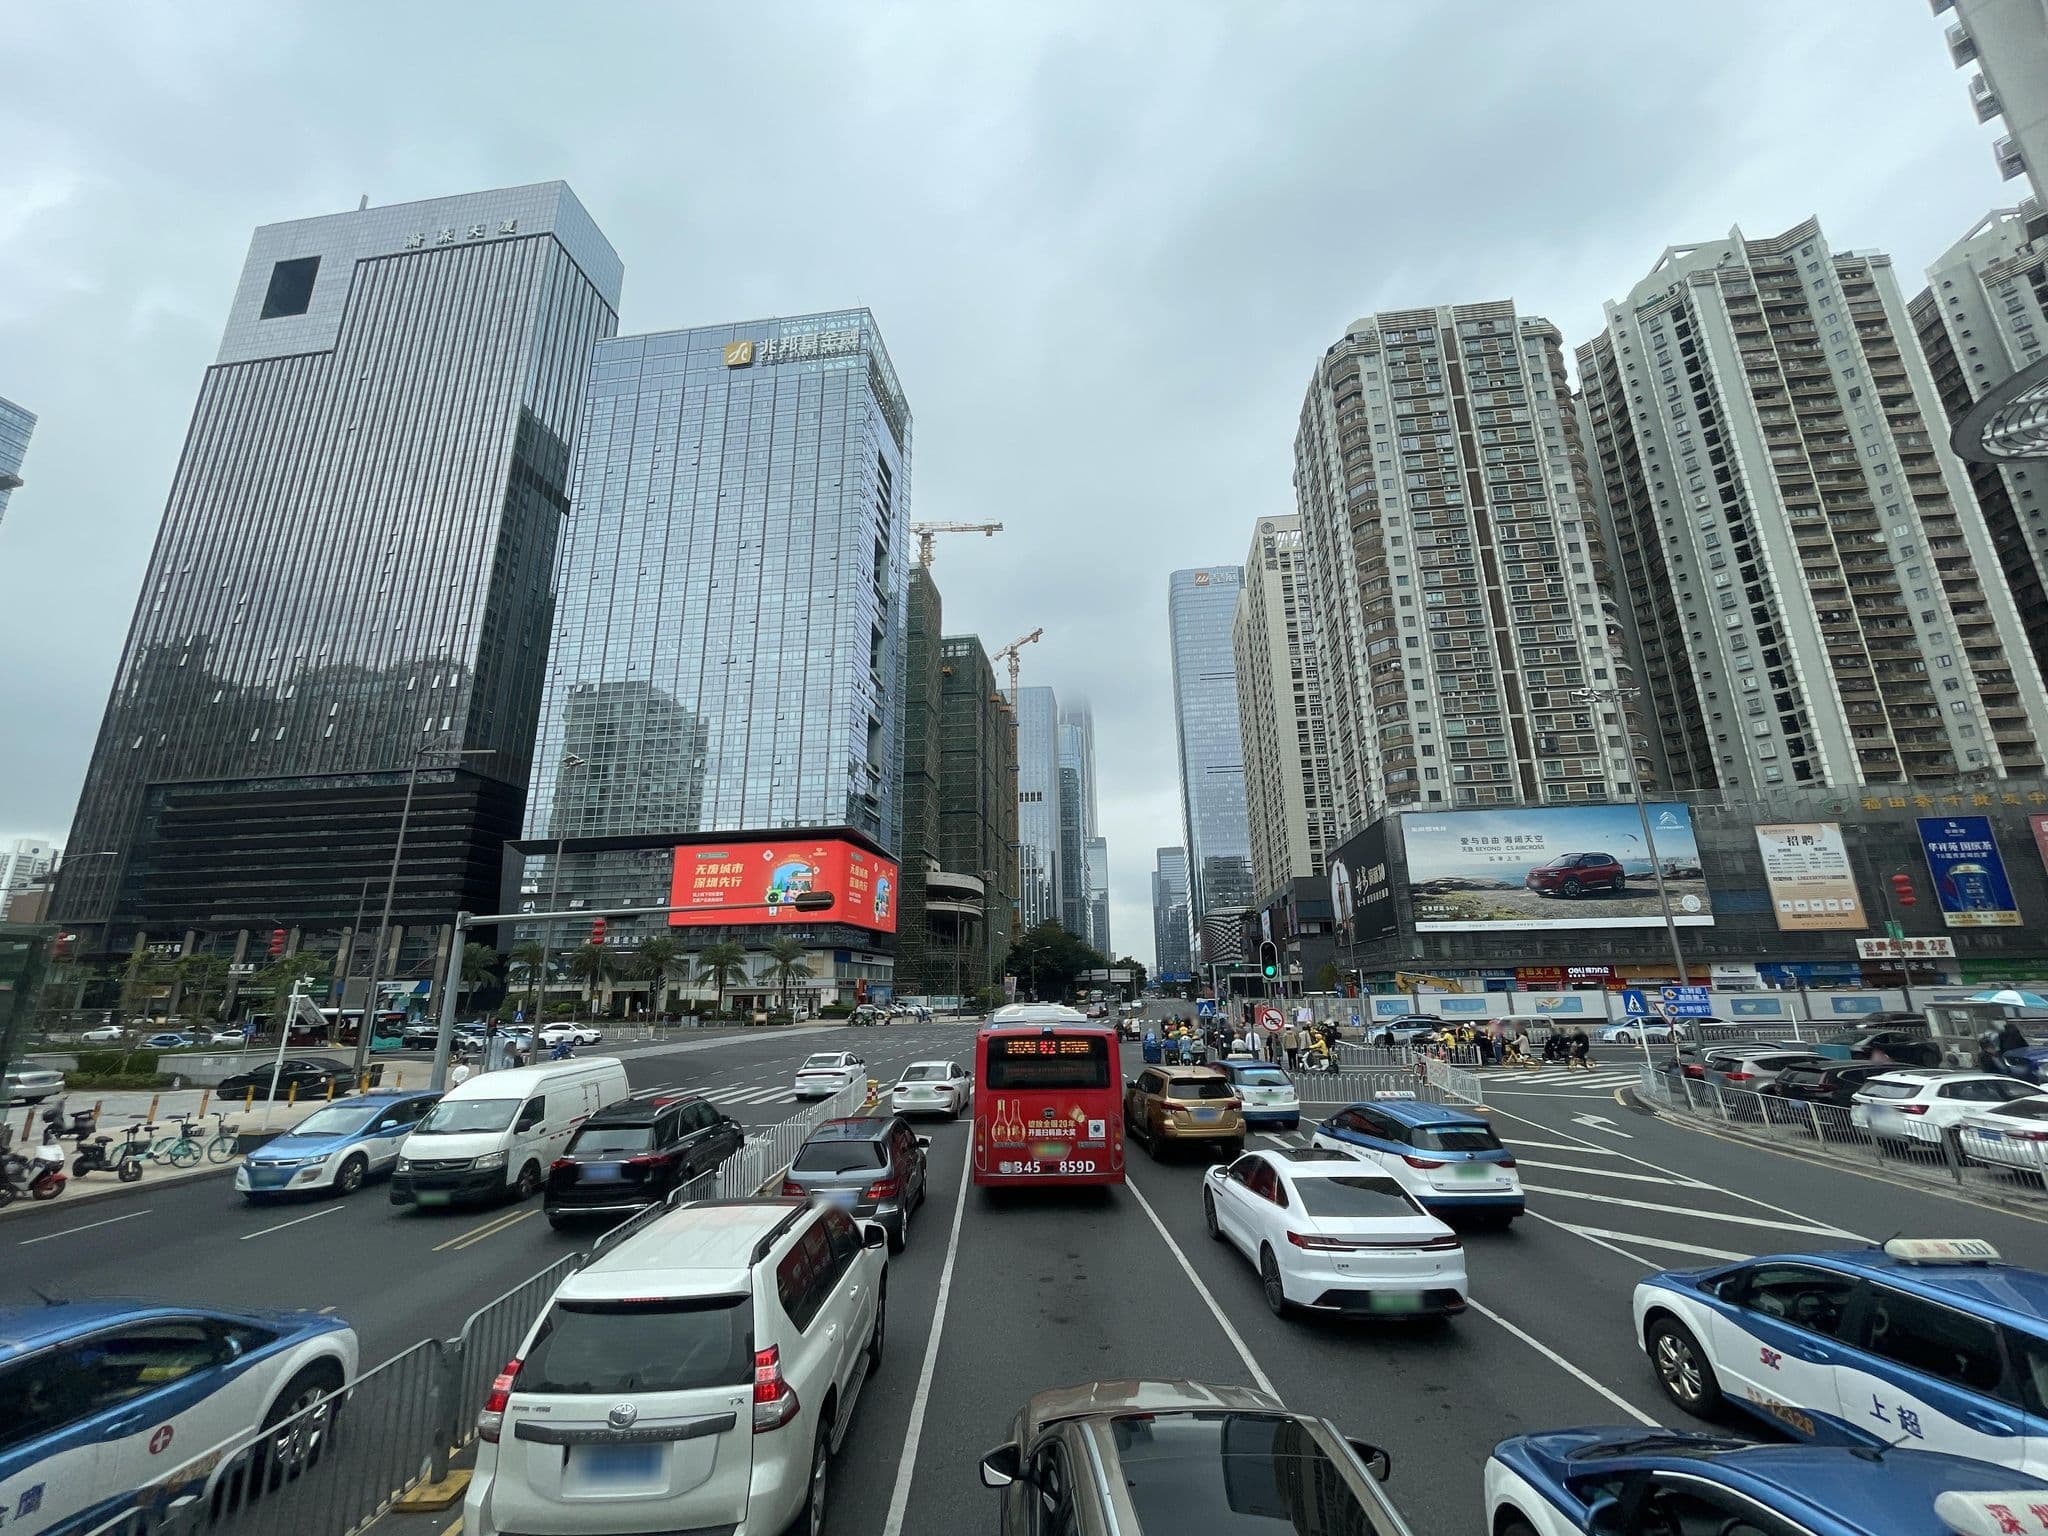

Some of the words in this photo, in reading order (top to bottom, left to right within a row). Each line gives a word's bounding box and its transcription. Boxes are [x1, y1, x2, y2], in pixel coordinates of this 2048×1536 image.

[759, 327, 860, 355] 兆邦基金融
[695, 863, 744, 875] 无废城市
[693, 876, 743, 888] 深圳先行
[1567, 966, 1585, 974] deli
[1059, 1161, 1096, 1173] 859D
[729, 1397, 744, 1405] TX
